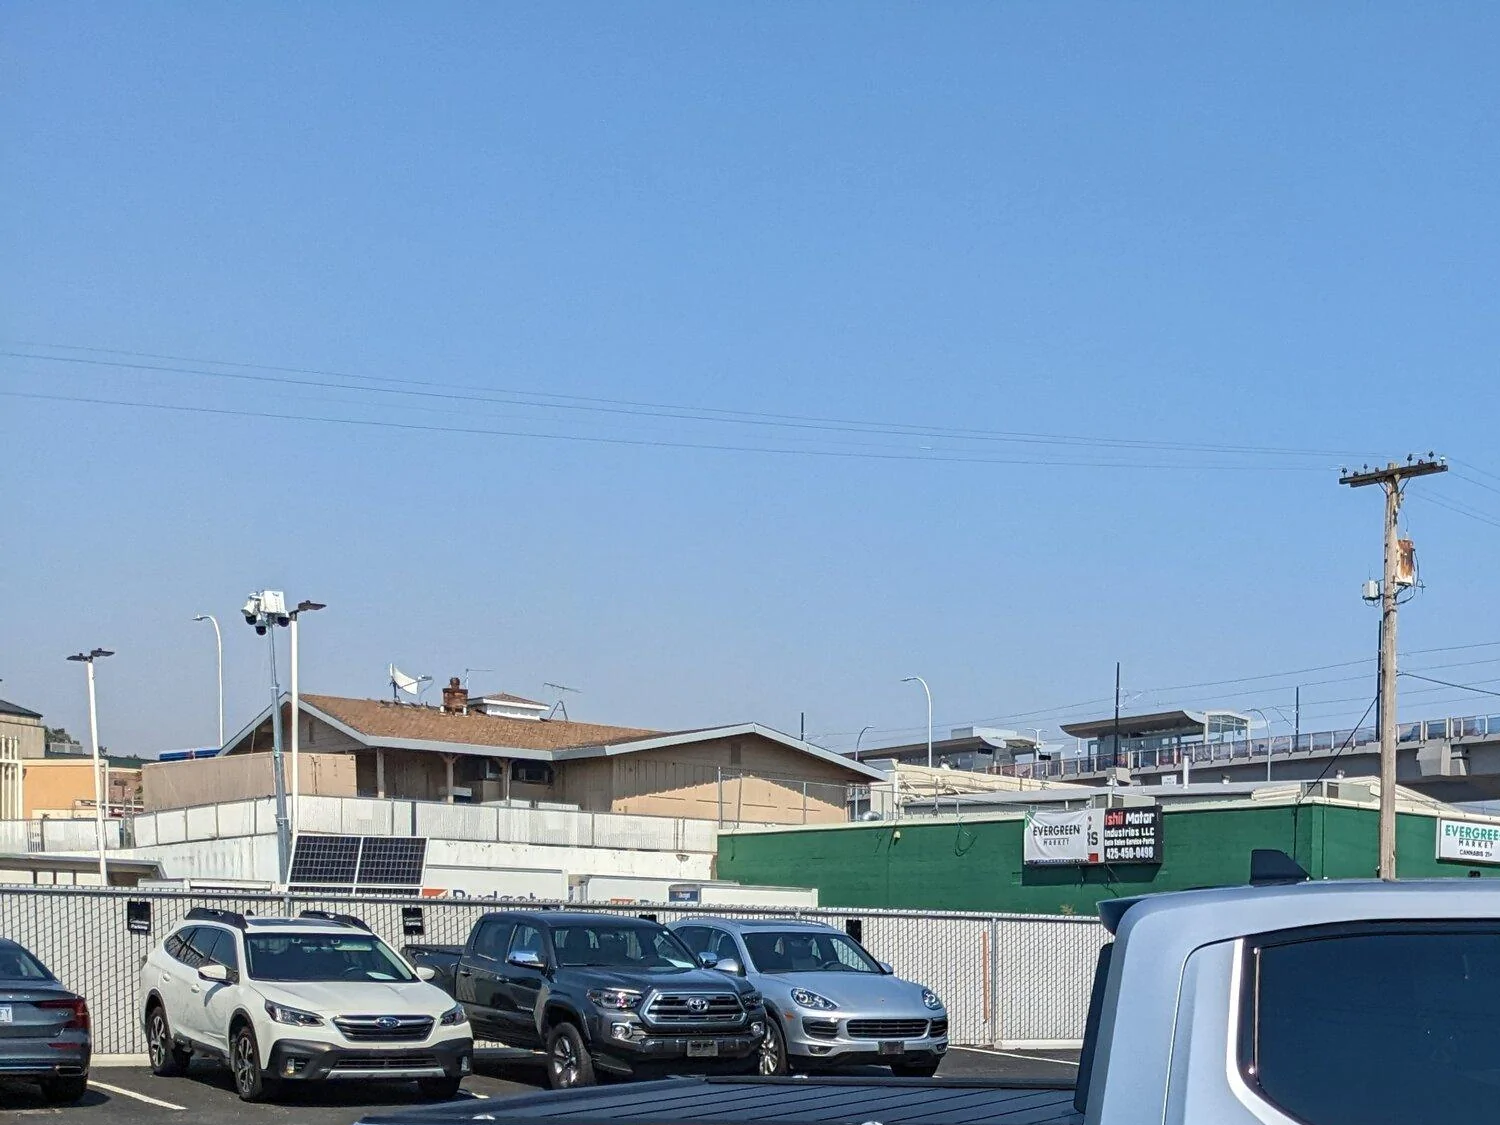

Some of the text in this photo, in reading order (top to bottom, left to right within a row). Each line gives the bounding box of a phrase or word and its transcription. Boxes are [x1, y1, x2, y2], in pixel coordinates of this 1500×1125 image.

[1105, 811, 1155, 825] Ishii Motor
[1033, 824, 1080, 837] EVERGREEN
[1105, 827, 1155, 837] Industries LLC
[1043, 838, 1069, 846] MARKET
[1459, 839, 1493, 849] MARKET
[1460, 849, 1483, 857] CANNABIS
